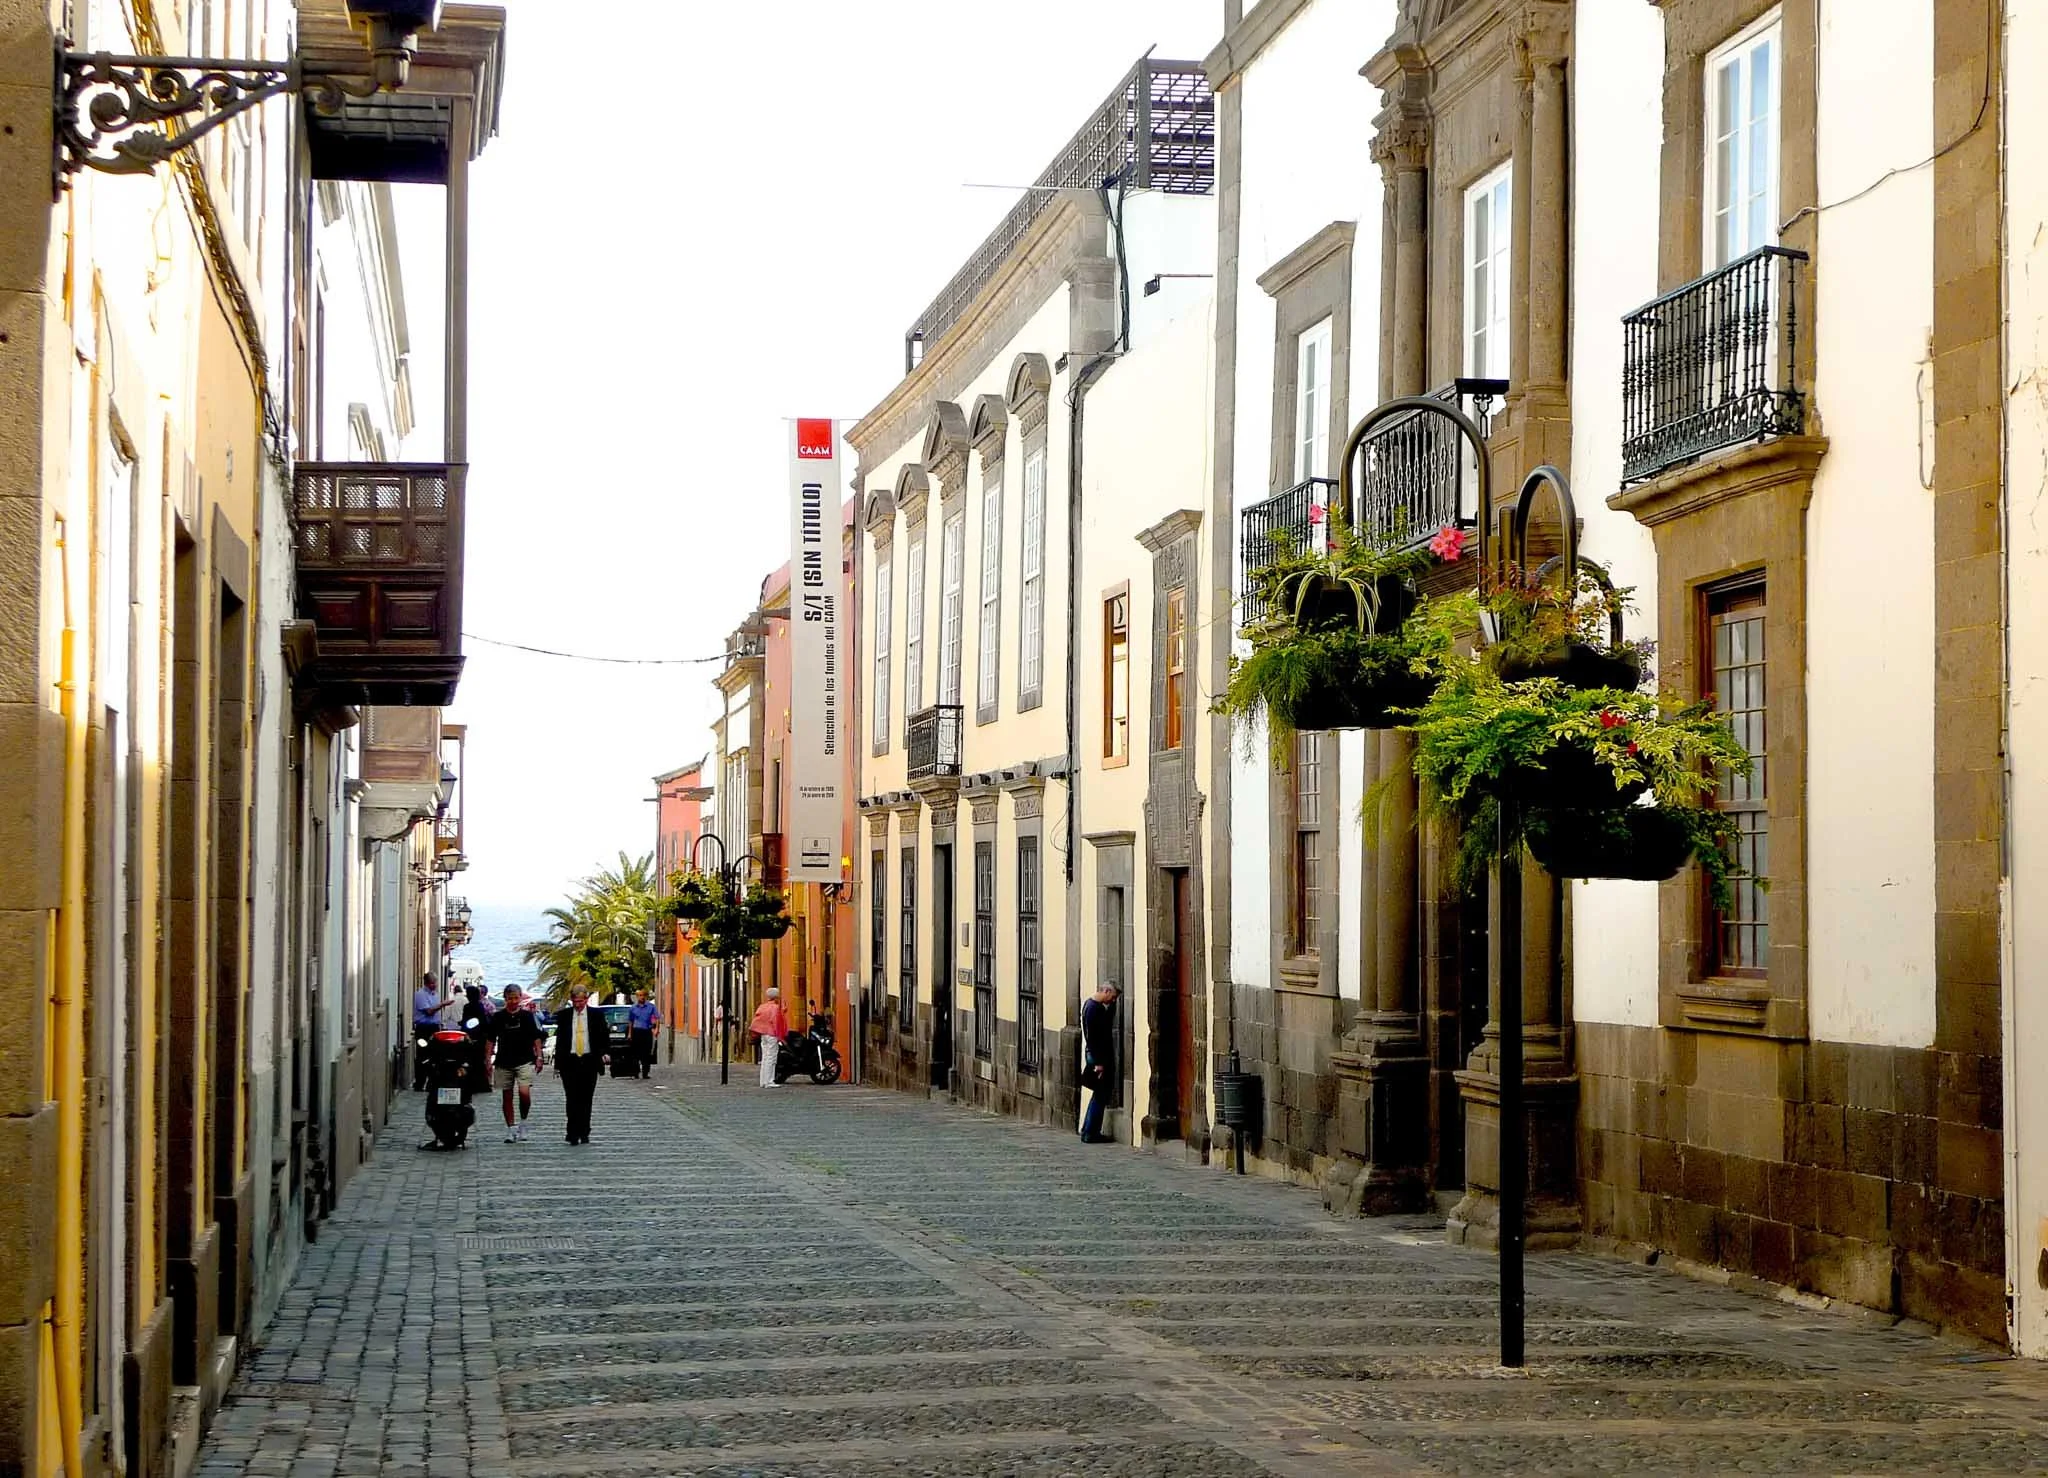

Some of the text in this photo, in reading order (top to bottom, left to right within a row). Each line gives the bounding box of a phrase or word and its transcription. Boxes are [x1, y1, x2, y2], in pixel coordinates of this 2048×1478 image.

[800, 445, 830, 455] CAAM
[801, 483, 823, 621] S/T (SIN TÍTULO)
[824, 595, 834, 623] CAAM
[824, 626, 835, 640] del
[824, 643, 835, 675] fondos
[824, 678, 835, 692] los
[824, 695, 835, 706] de
